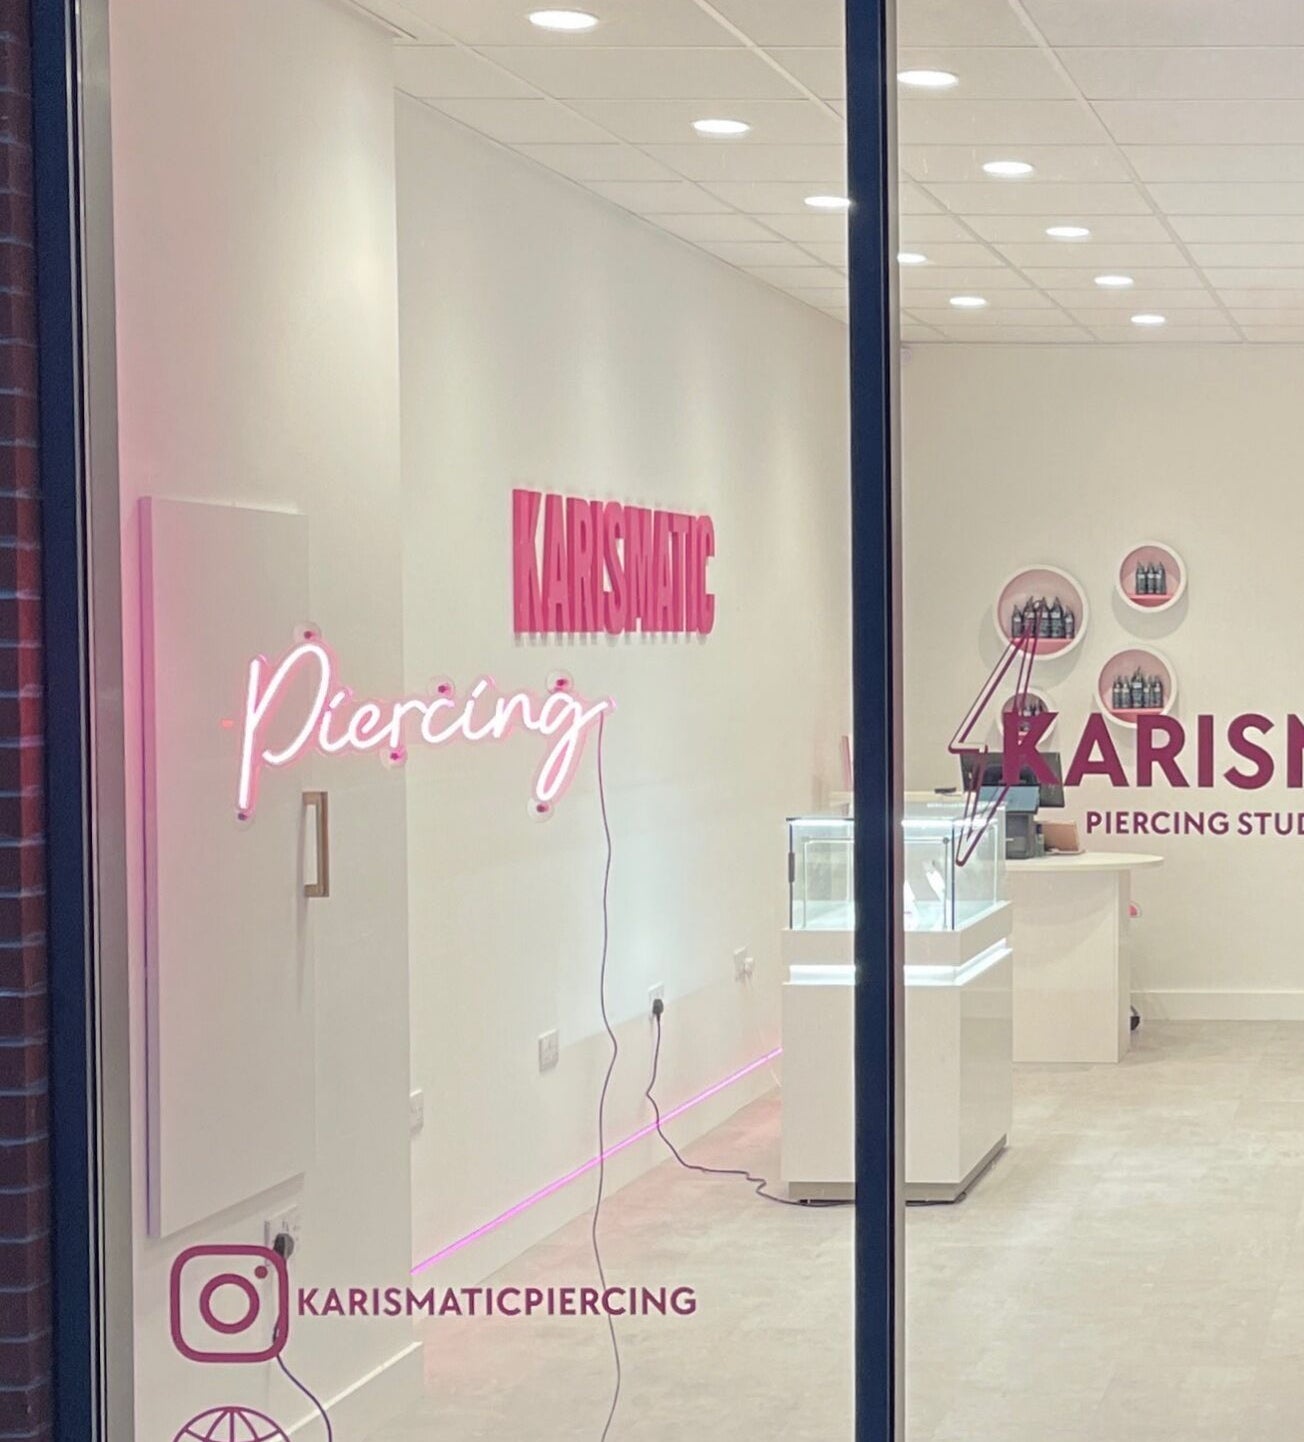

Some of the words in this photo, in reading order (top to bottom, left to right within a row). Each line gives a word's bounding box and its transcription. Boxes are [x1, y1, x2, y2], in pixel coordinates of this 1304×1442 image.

[512, 488, 715, 635] KARISMATIC
[238, 641, 610, 809] Piercing
[1085, 810, 1229, 836] PIERCING
[298, 1286, 697, 1316] KARISMATICPIERCING
